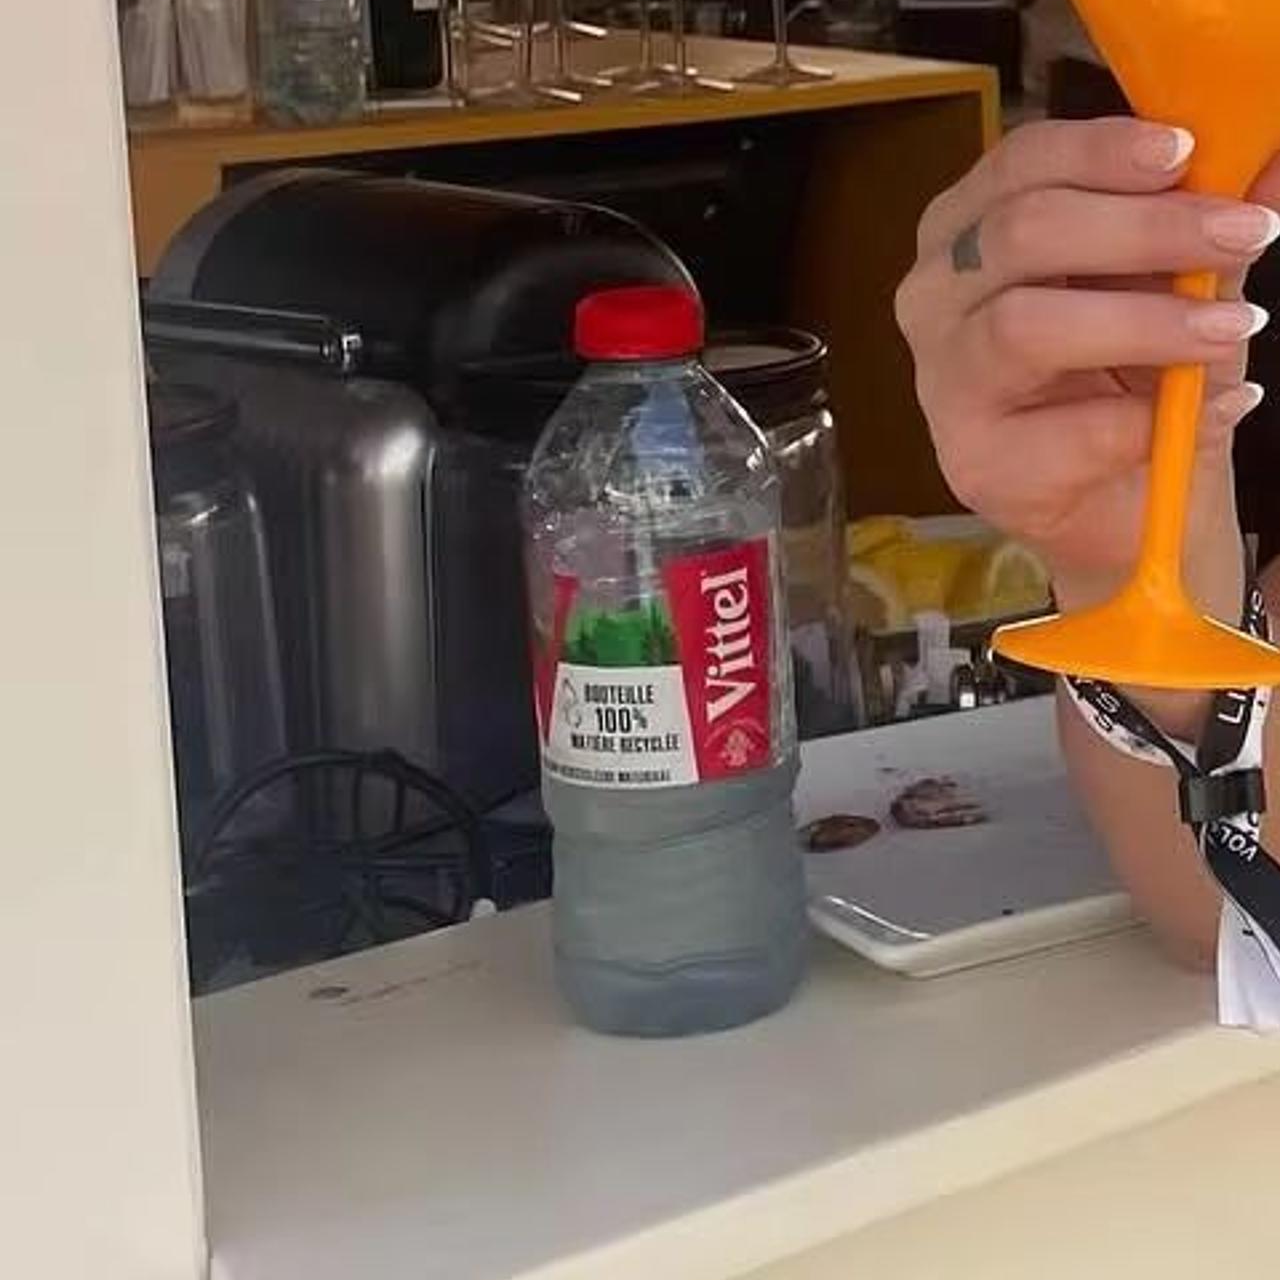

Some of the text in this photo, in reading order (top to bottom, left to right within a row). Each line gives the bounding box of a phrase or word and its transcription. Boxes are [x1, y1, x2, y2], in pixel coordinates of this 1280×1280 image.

[700, 567, 757, 723] Vittel
[584, 683, 655, 705] BOUTEILLE
[595, 706, 649, 734] 100%
